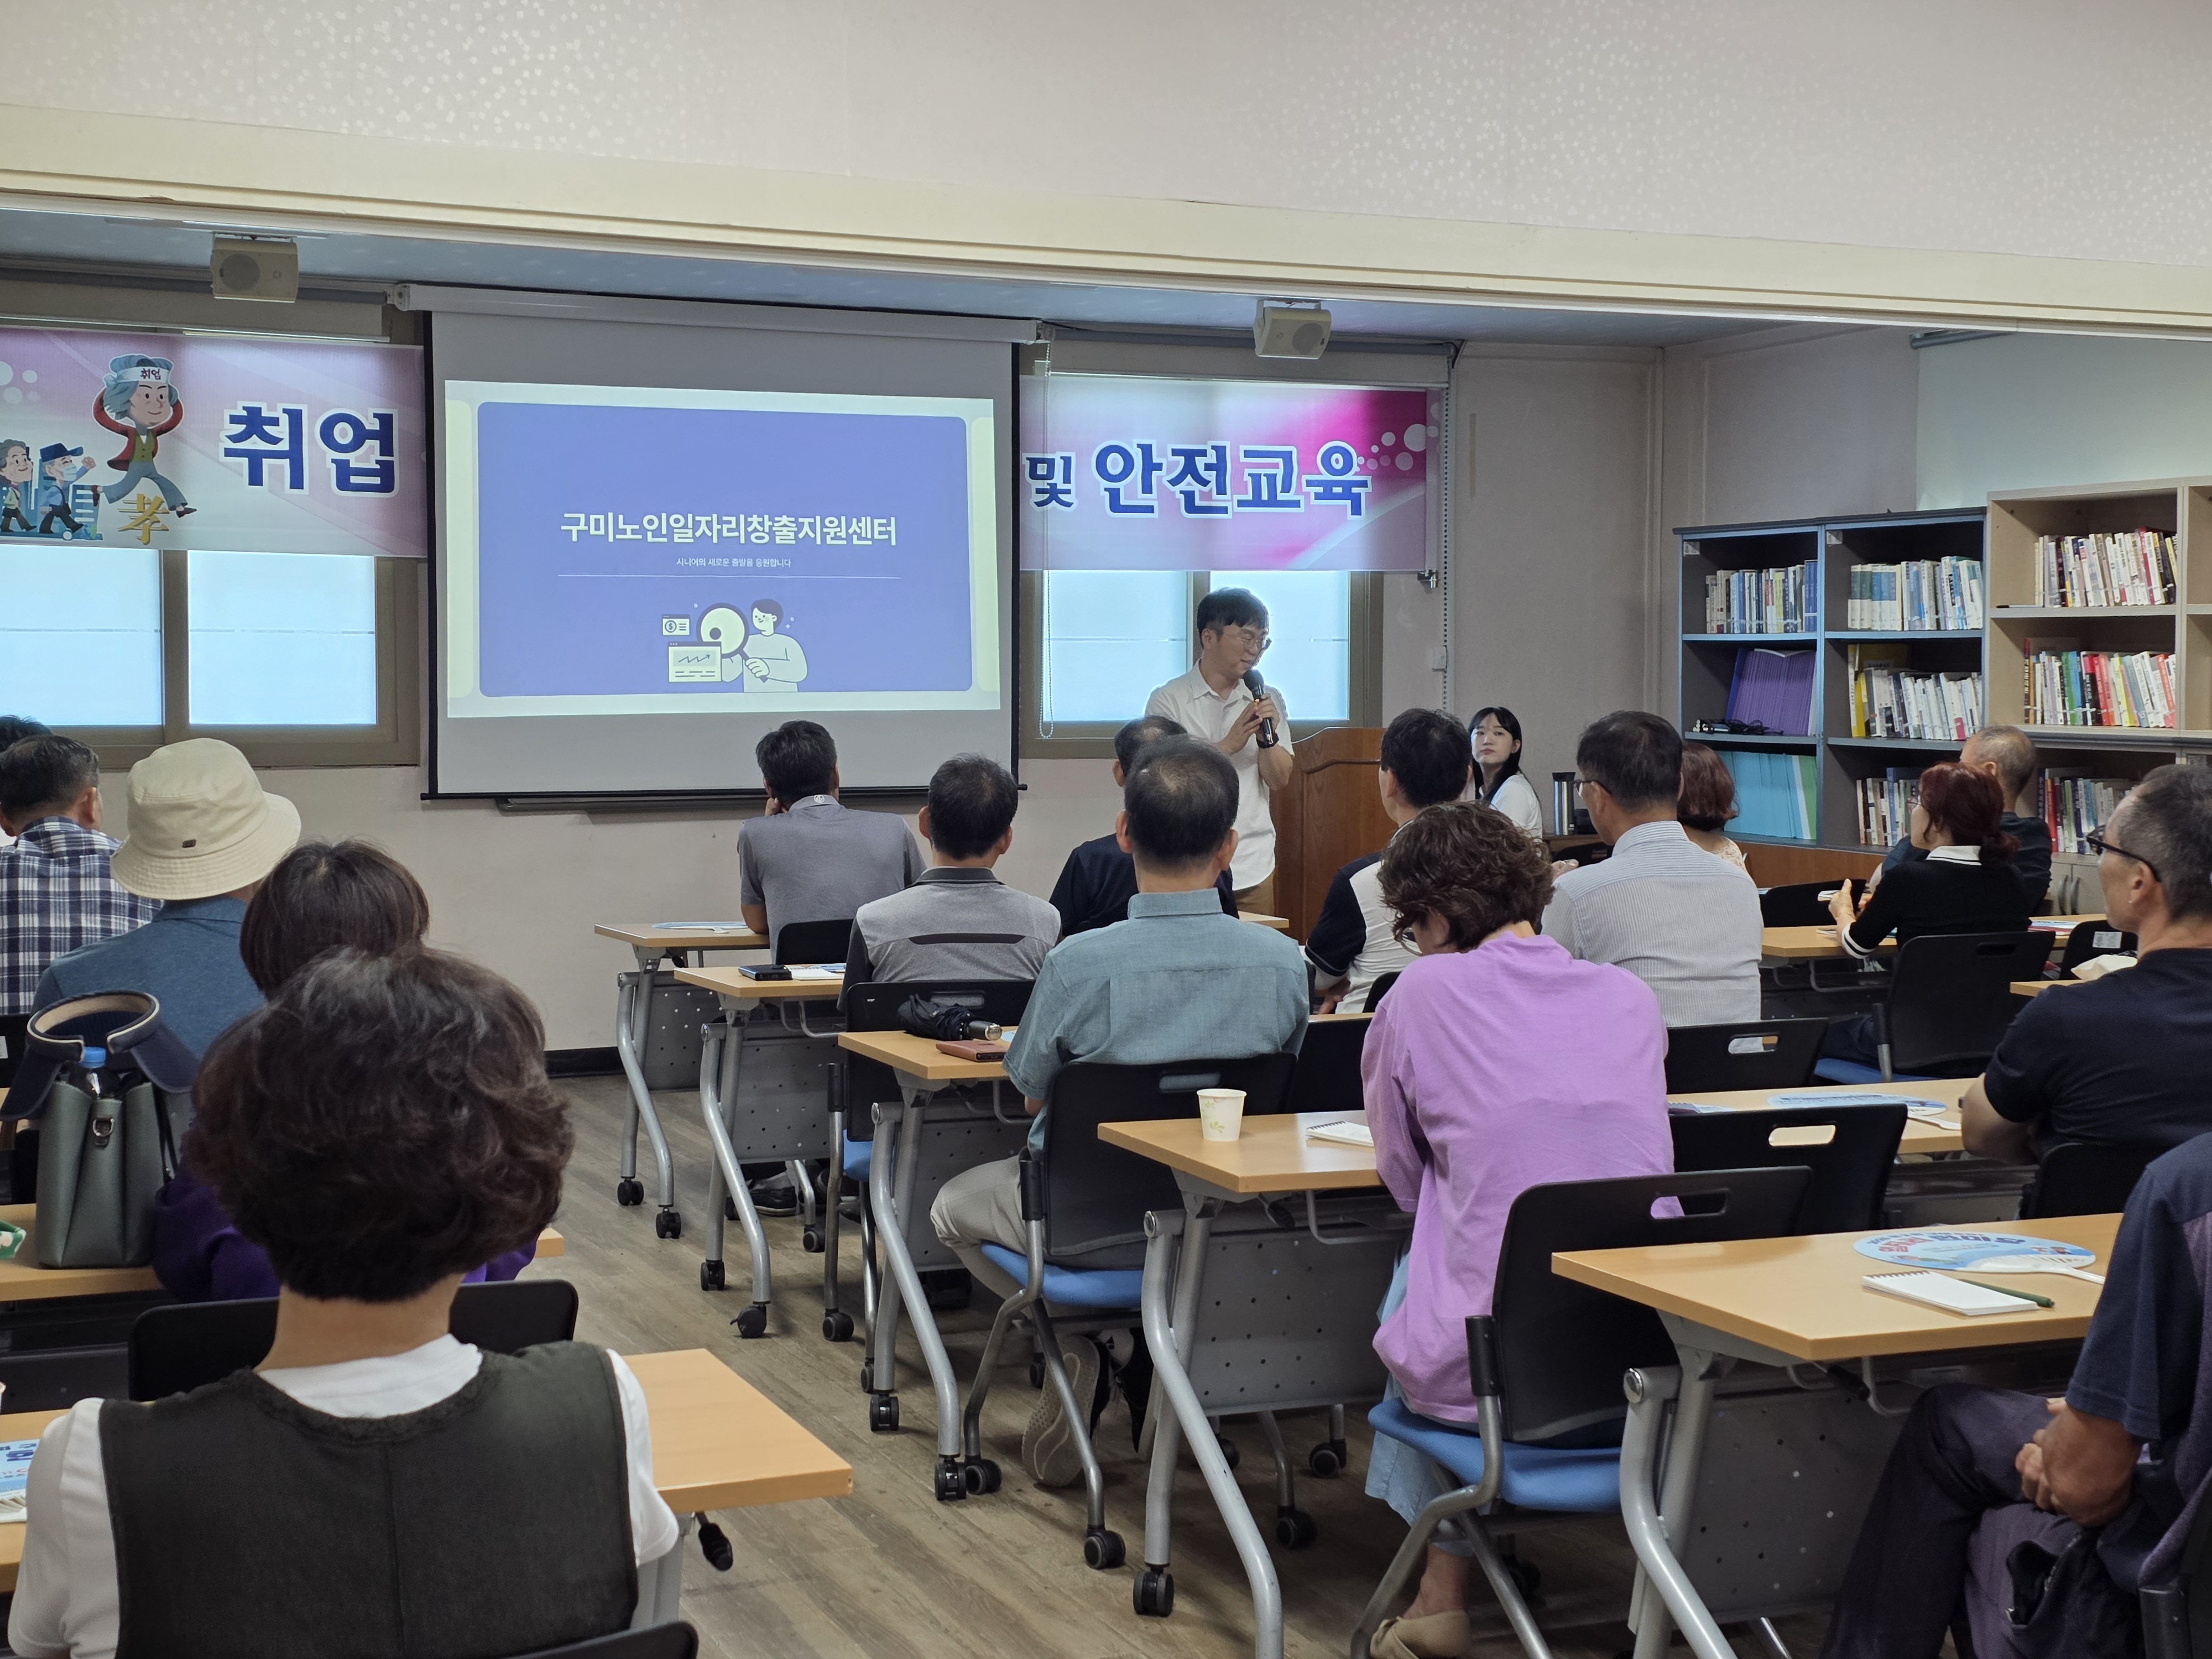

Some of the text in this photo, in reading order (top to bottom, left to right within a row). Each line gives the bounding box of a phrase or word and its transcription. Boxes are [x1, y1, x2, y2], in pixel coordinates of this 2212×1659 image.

[140, 368, 161, 380] 취업
[223, 405, 1369, 517] 취업 및 안전교육
[117, 493, 170, 545] 孝
[561, 512, 897, 546] 구미노인일자리창출지원센터
[676, 557, 791, 568] 시니어의 새로운 출발을 응원합니다
